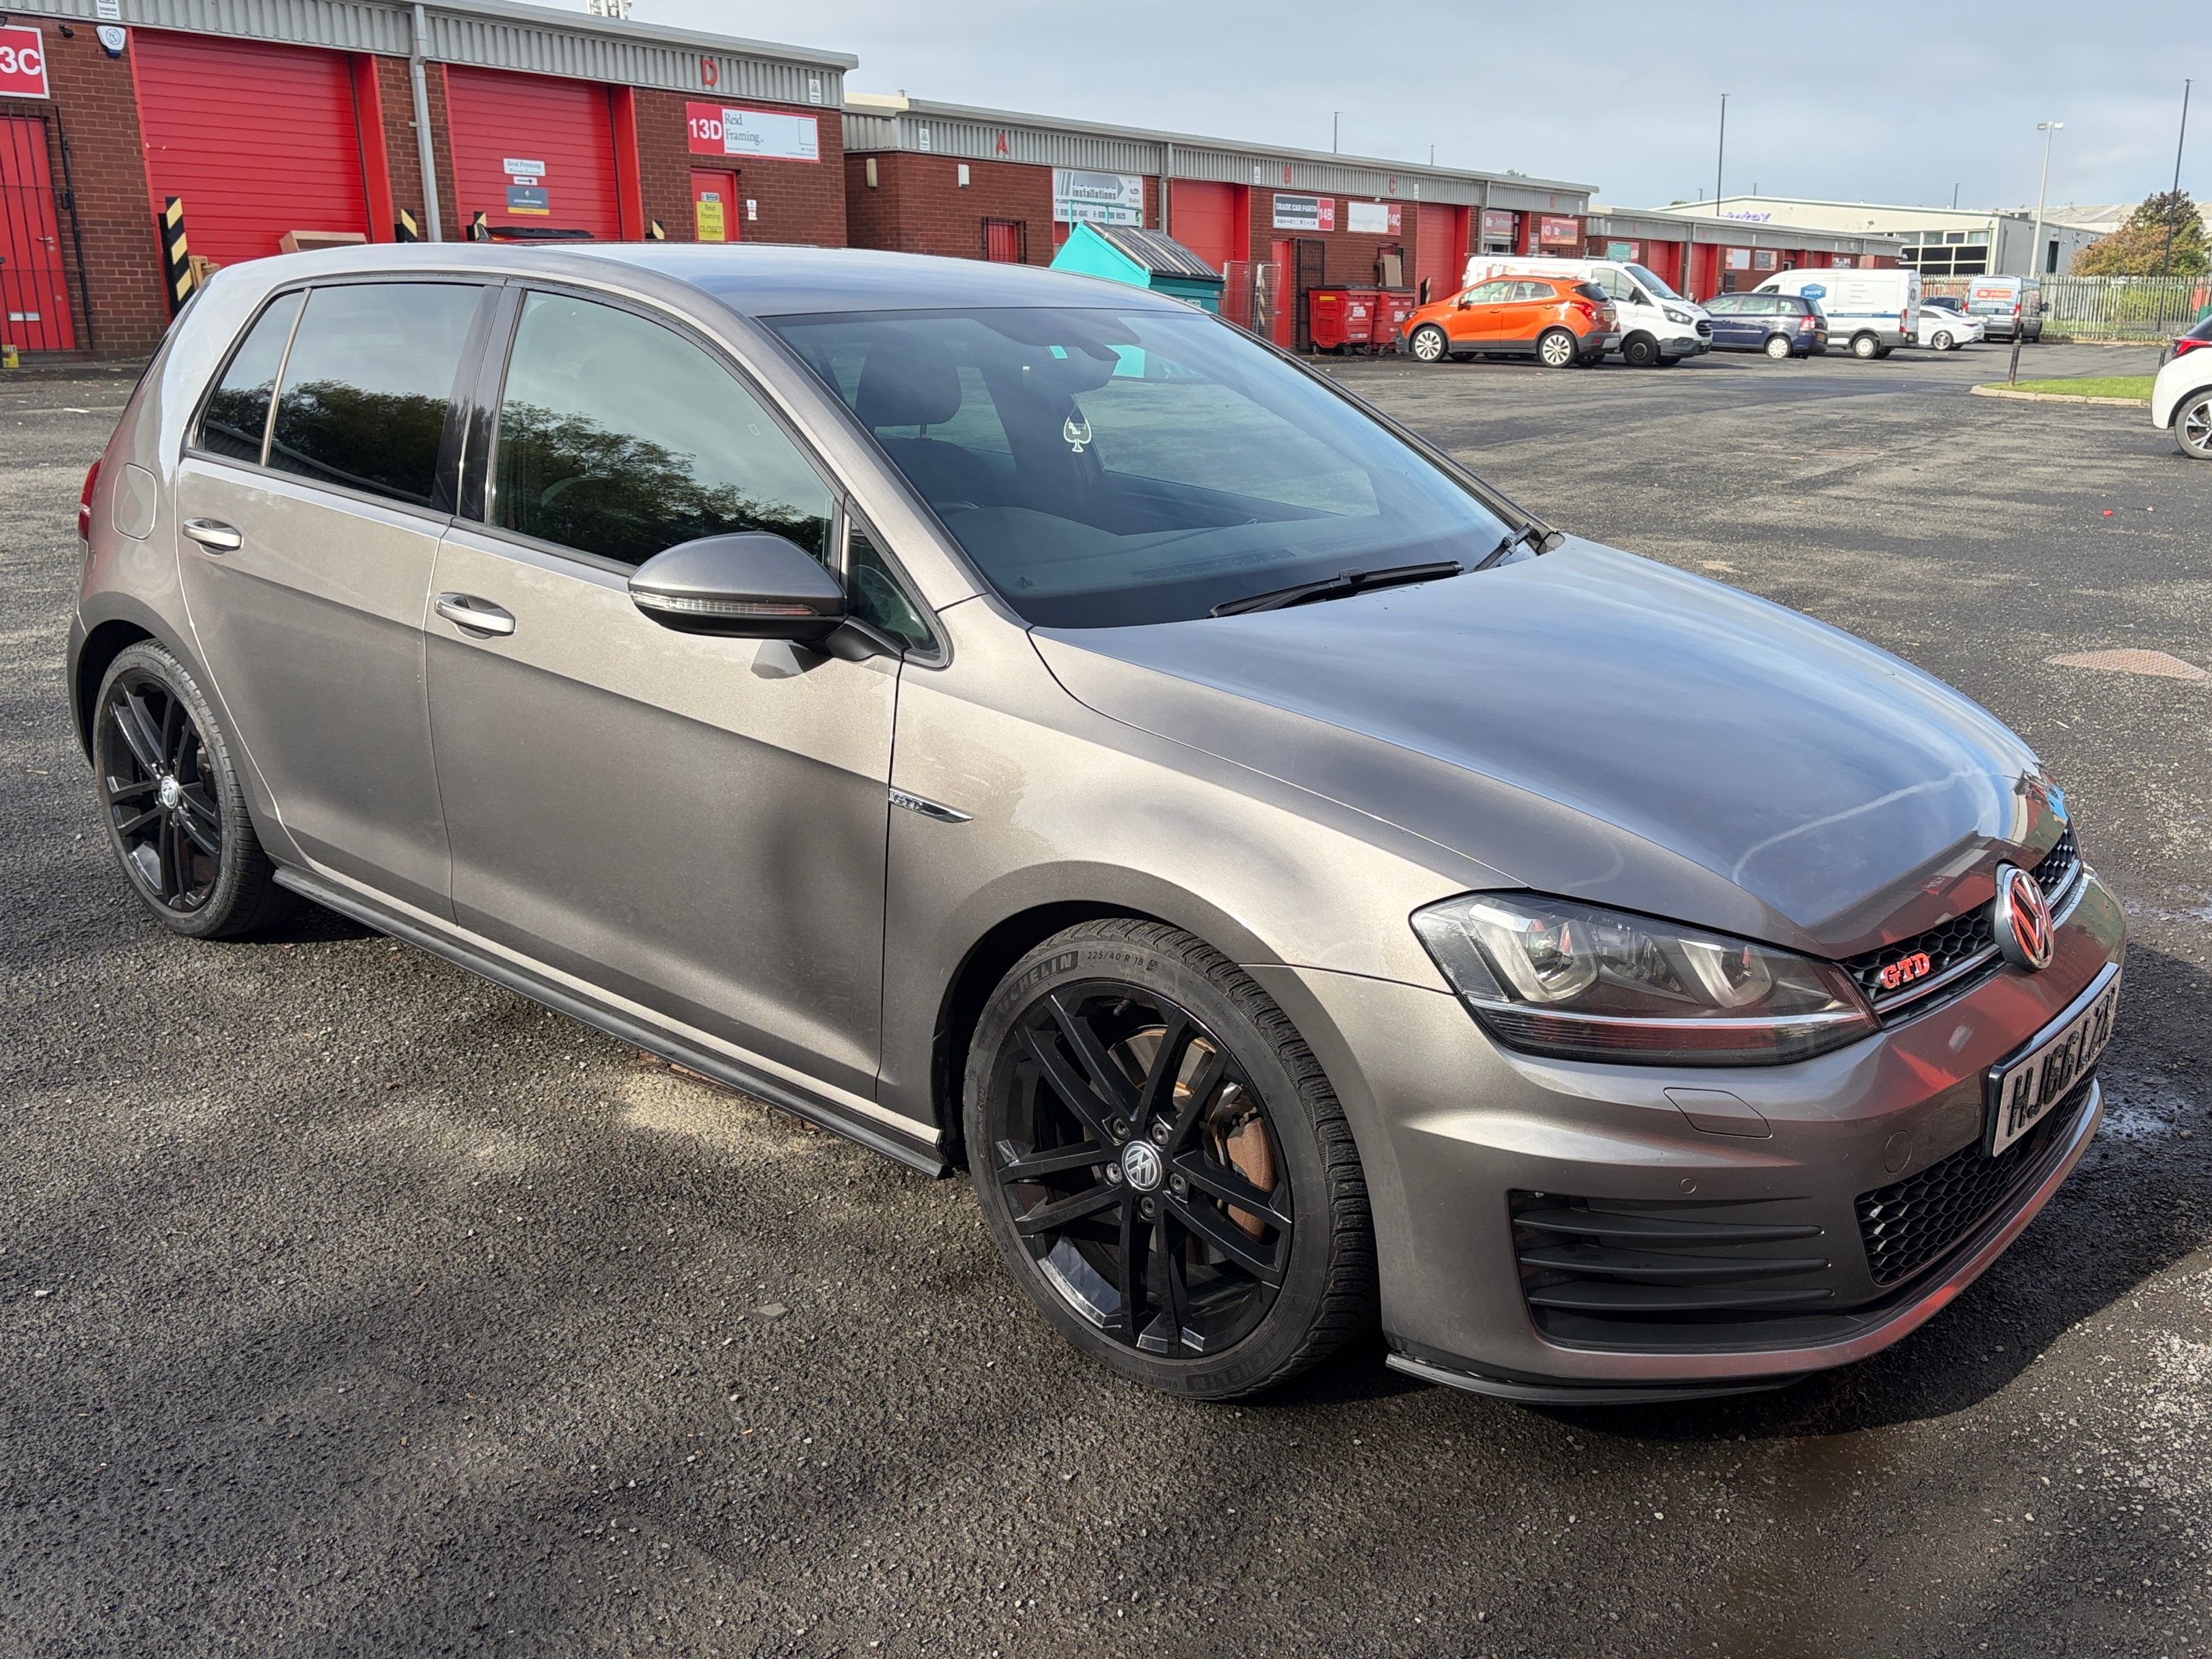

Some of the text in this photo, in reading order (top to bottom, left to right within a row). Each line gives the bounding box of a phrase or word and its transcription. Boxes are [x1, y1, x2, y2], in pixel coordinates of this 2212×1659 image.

[0, 46, 41, 75] 3C
[701, 59, 718, 86] D
[724, 113, 743, 126] Reid
[689, 118, 722, 140] 13D
[726, 128, 761, 146] Framing
[996, 131, 1009, 156] A
[1072, 187, 1117, 200] installations
[1292, 204, 1302, 212] CAR
[1319, 208, 1333, 221] 14B
[1388, 213, 1401, 226] 14C
[892, 793, 923, 812] GTD
[1087, 950, 1145, 966] 225/40 R 18
[1881, 952, 1931, 989] GTD
